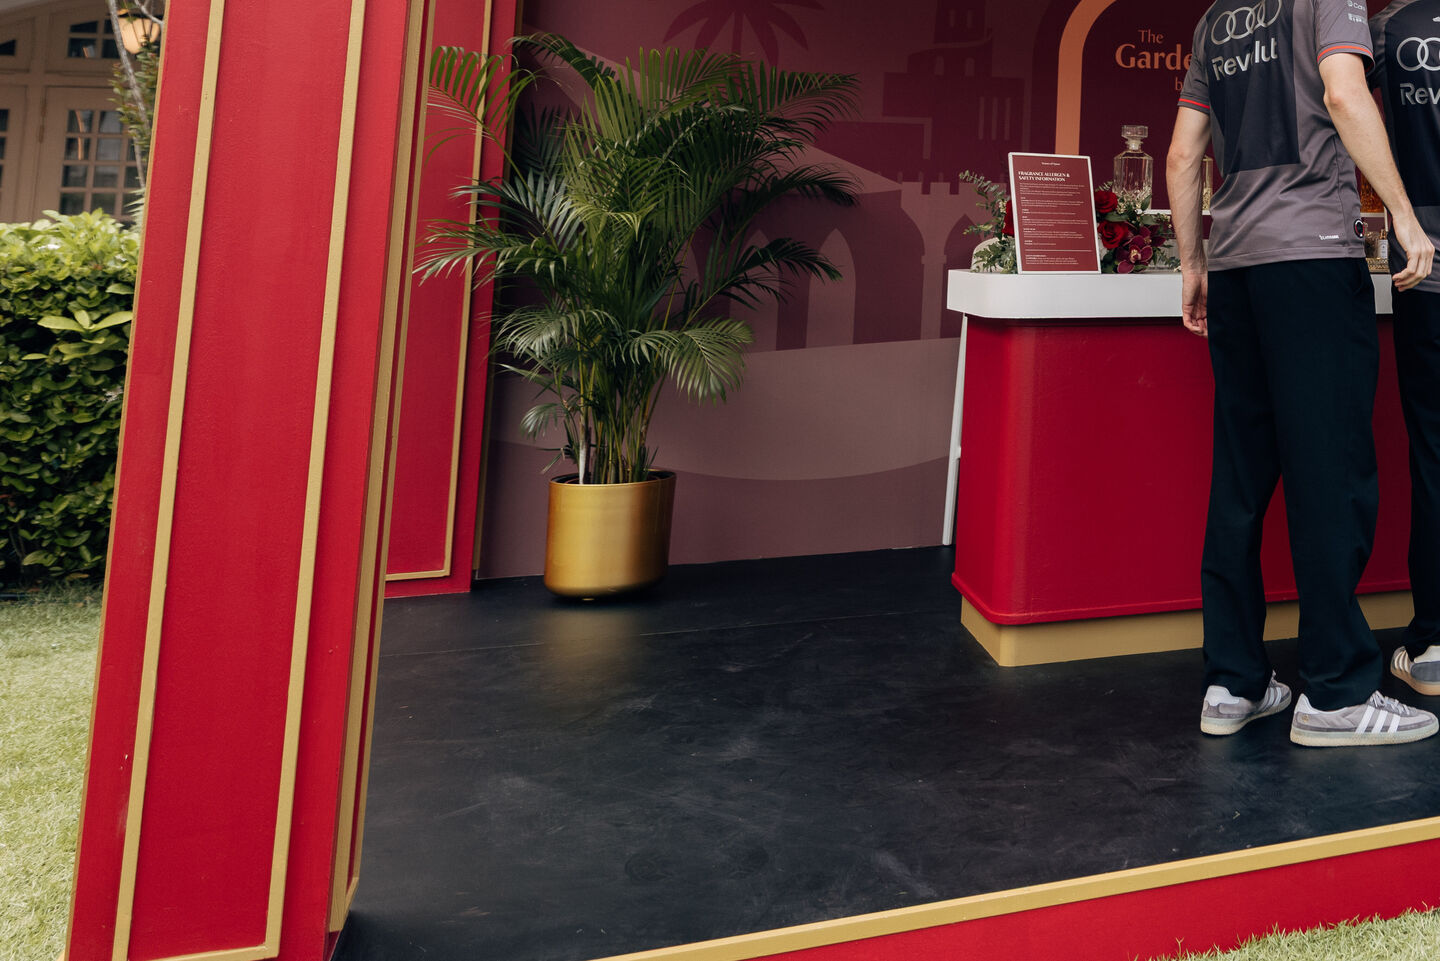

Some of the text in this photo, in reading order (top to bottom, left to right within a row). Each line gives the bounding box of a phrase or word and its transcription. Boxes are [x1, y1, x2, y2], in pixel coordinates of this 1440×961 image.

[1138, 29, 1164, 44] The
[1115, 43, 1193, 71] Garde
[1211, 37, 1278, 81] Revlut
